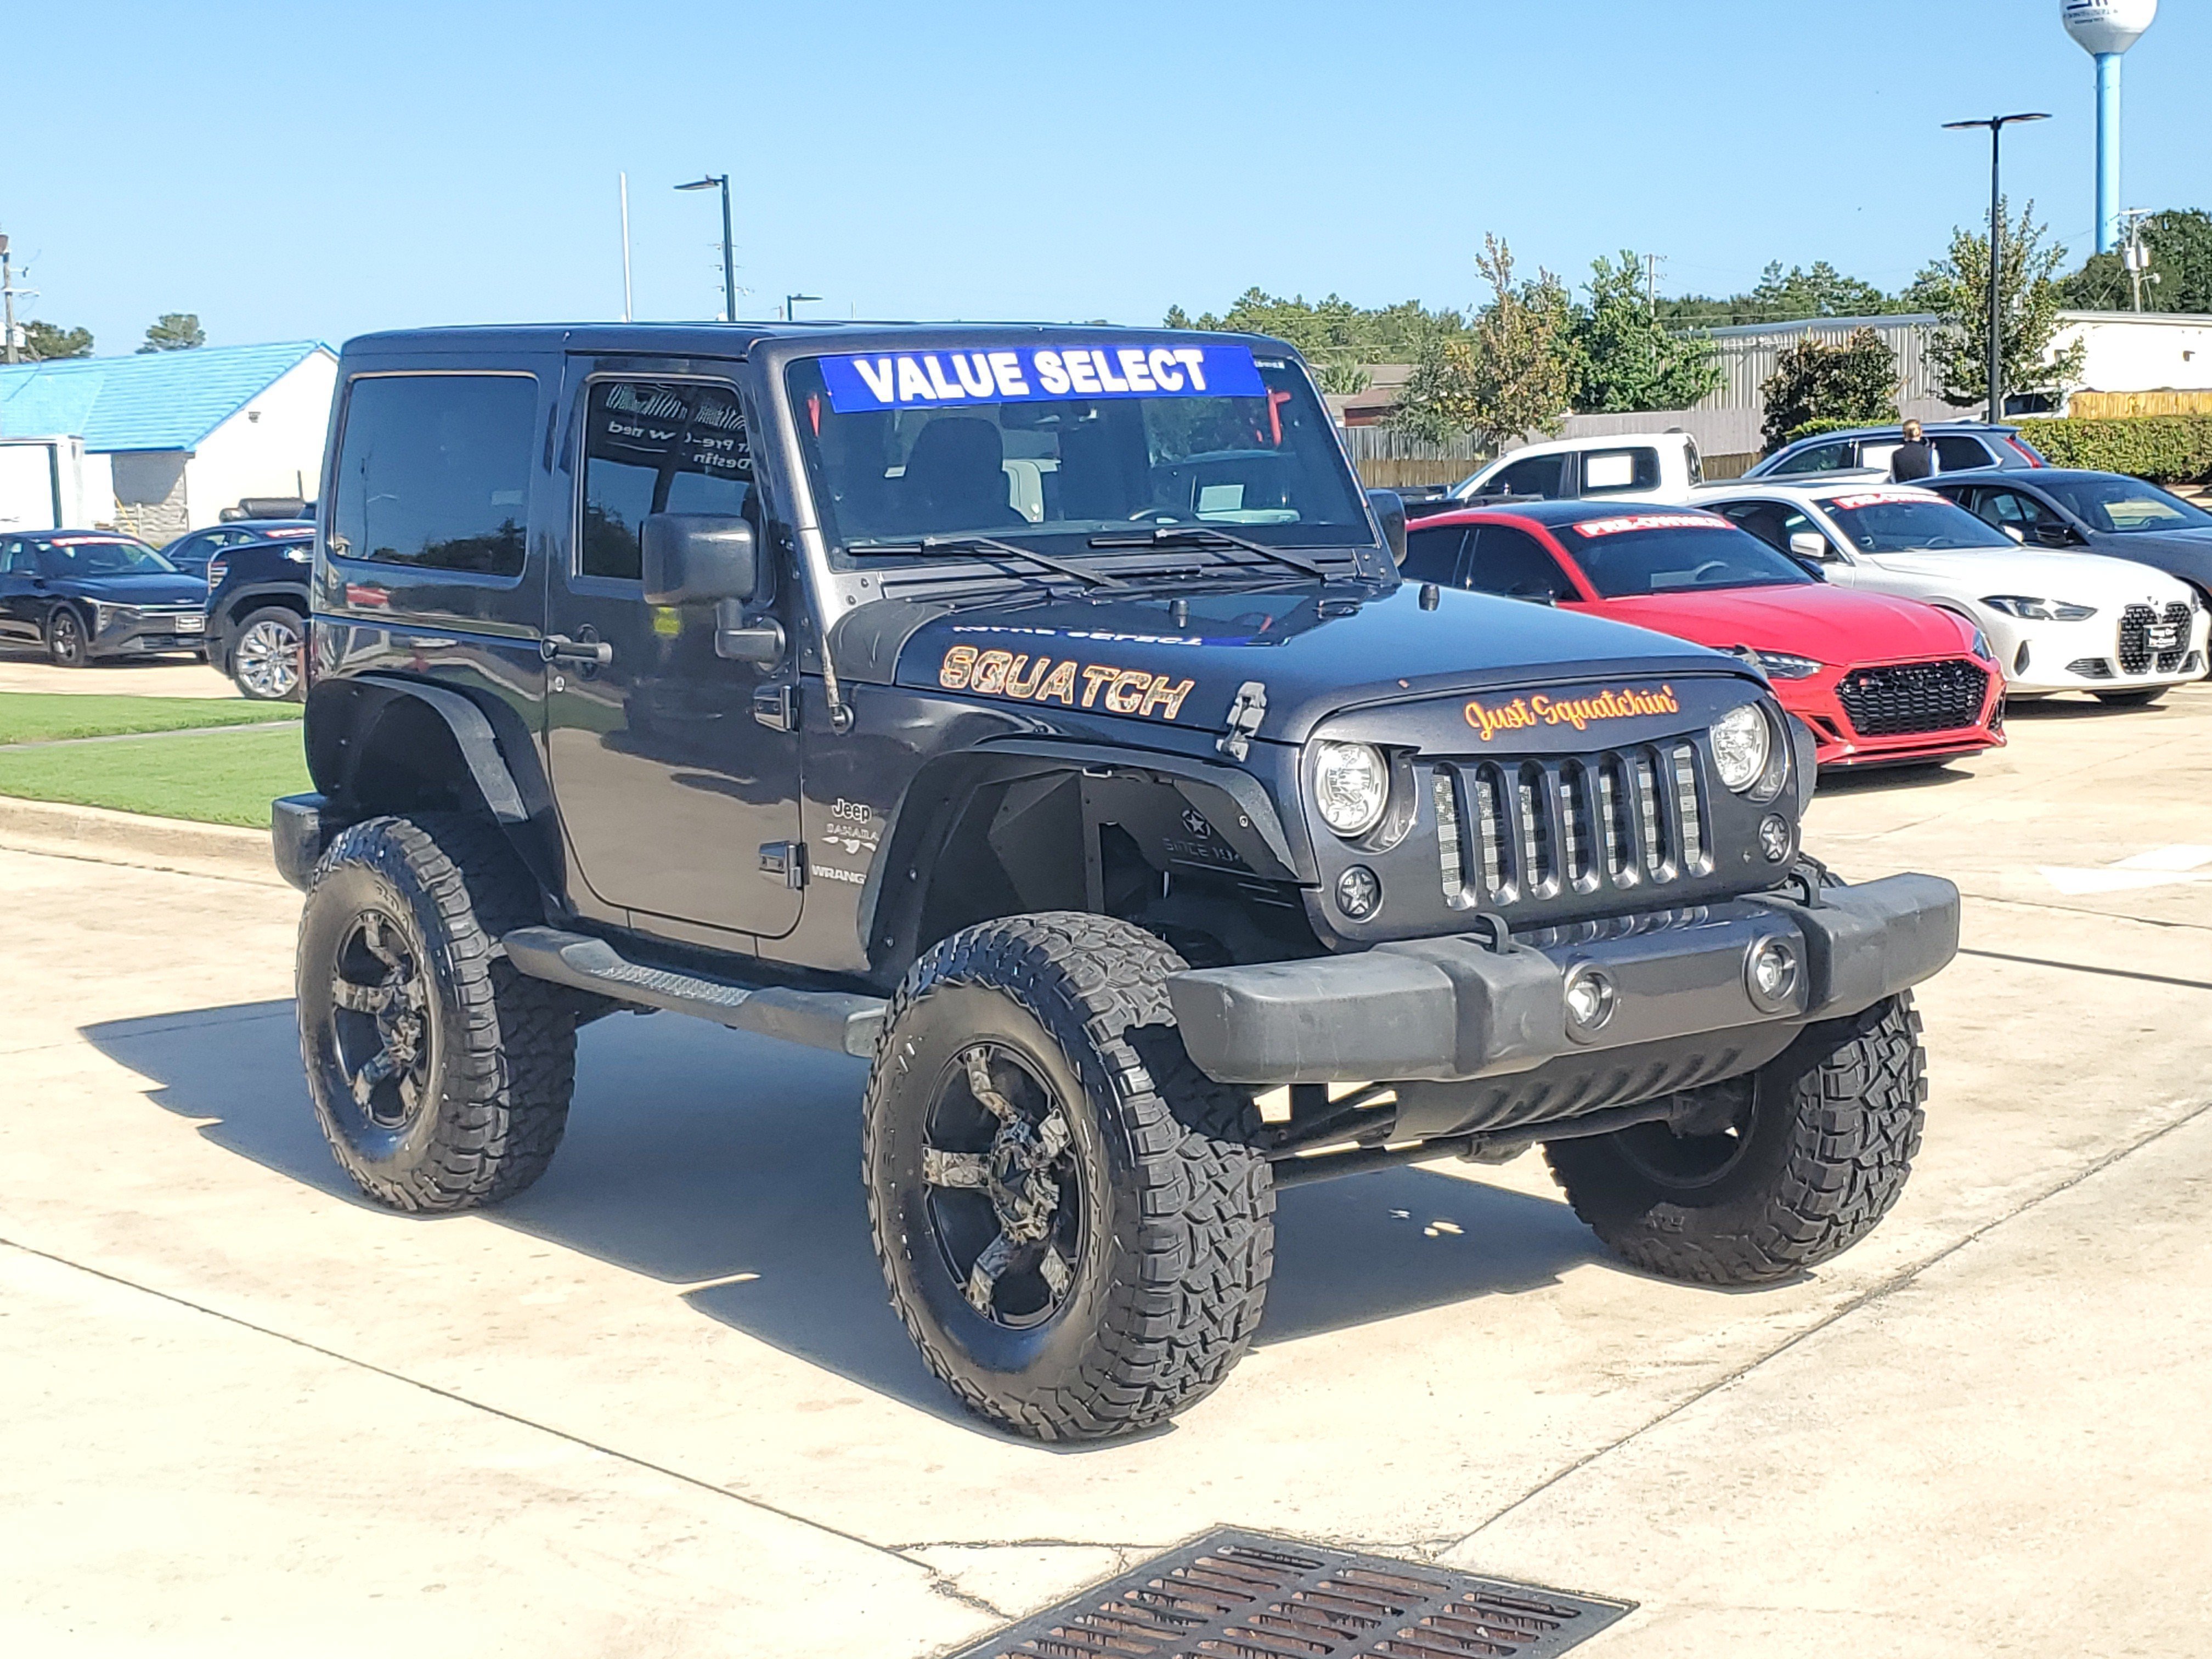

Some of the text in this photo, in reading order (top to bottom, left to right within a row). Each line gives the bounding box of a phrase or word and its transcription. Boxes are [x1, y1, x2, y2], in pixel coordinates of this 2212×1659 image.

[854, 349, 1205, 403] VALUE SELECT
[940, 646, 1195, 720] SQUATCH
[1464, 684, 1679, 742] Just Squatchin'
[832, 798, 872, 824] Jeep
